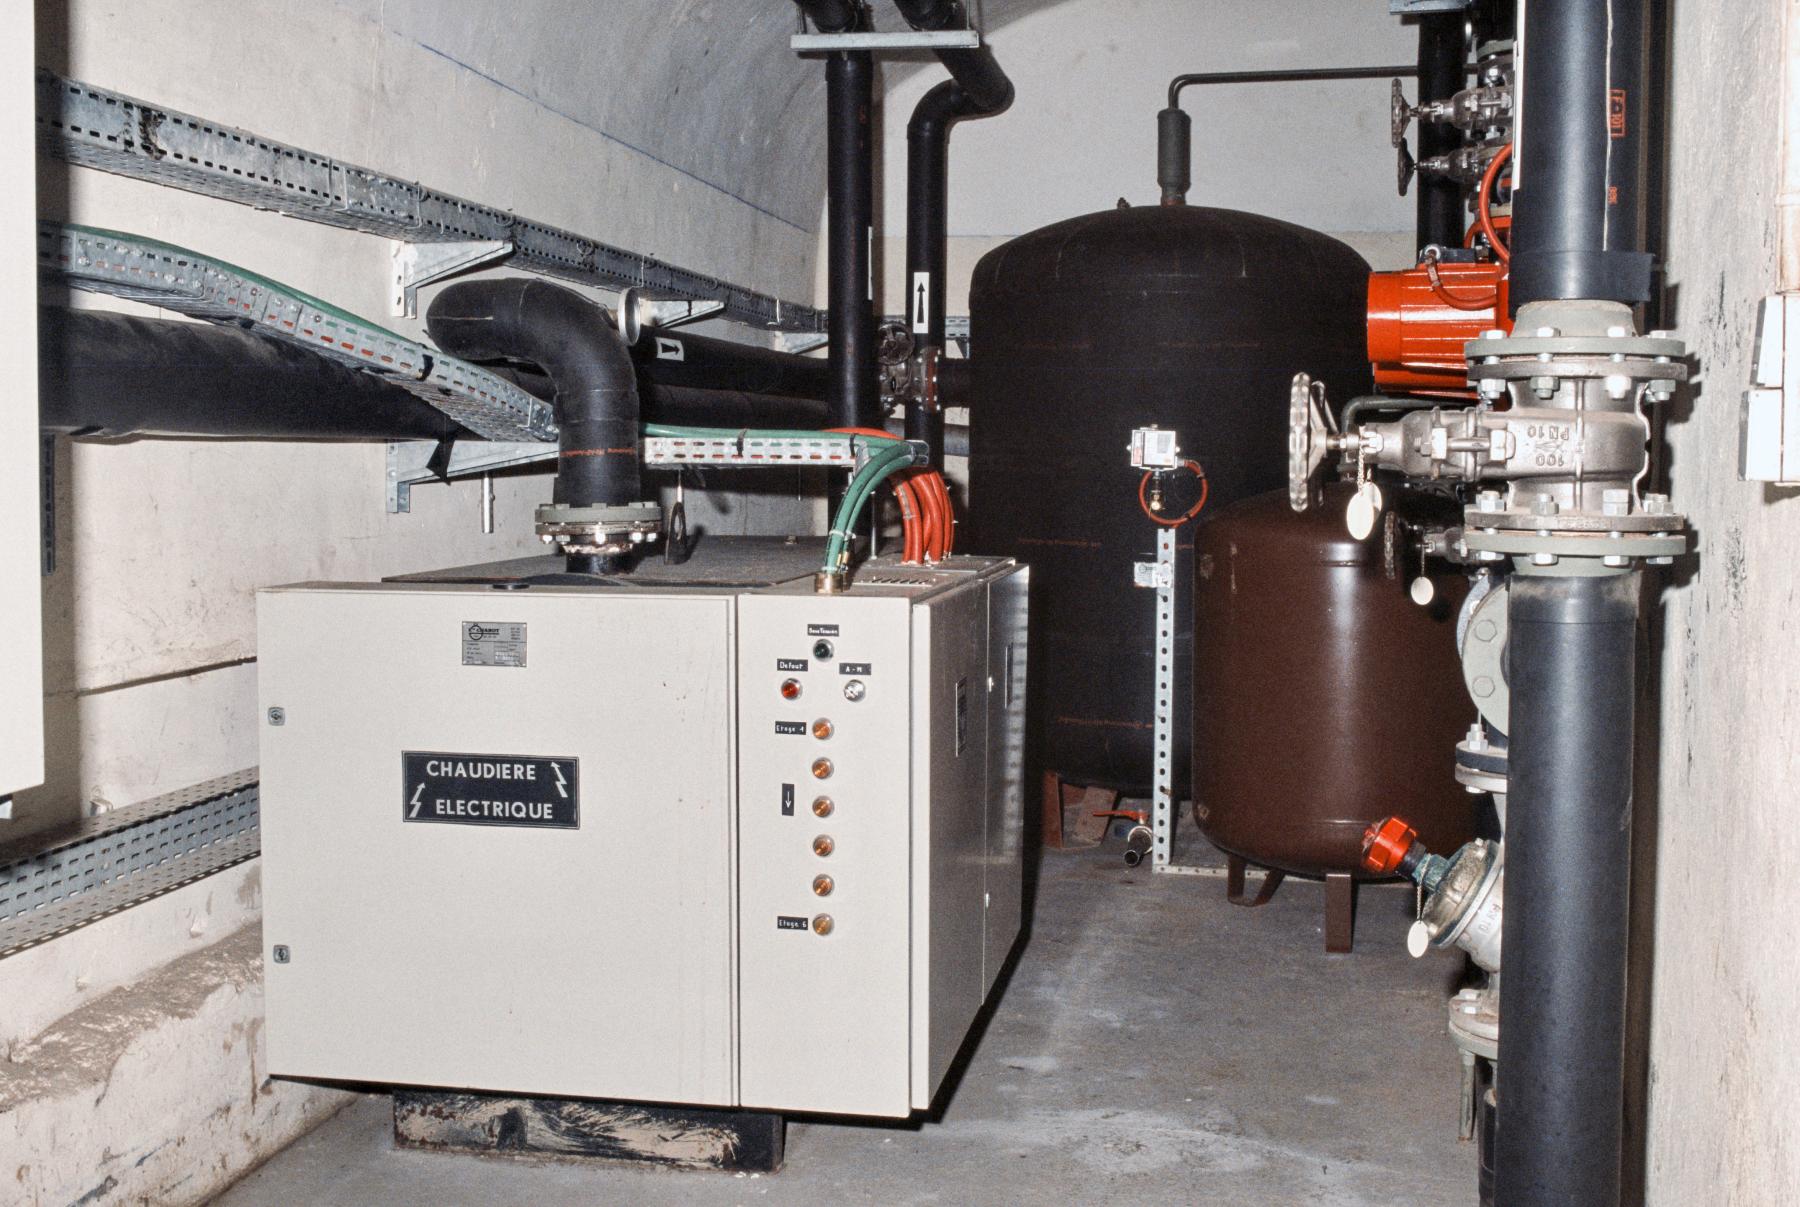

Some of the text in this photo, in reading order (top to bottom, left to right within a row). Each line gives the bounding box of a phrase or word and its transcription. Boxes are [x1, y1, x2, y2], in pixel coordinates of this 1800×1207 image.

[1527, 425, 1570, 441] PN 10
[1536, 453, 1565, 467] 100
[426, 760, 536, 780] CHAUDIERE
[436, 799, 553, 819] ELECTRIQUE
